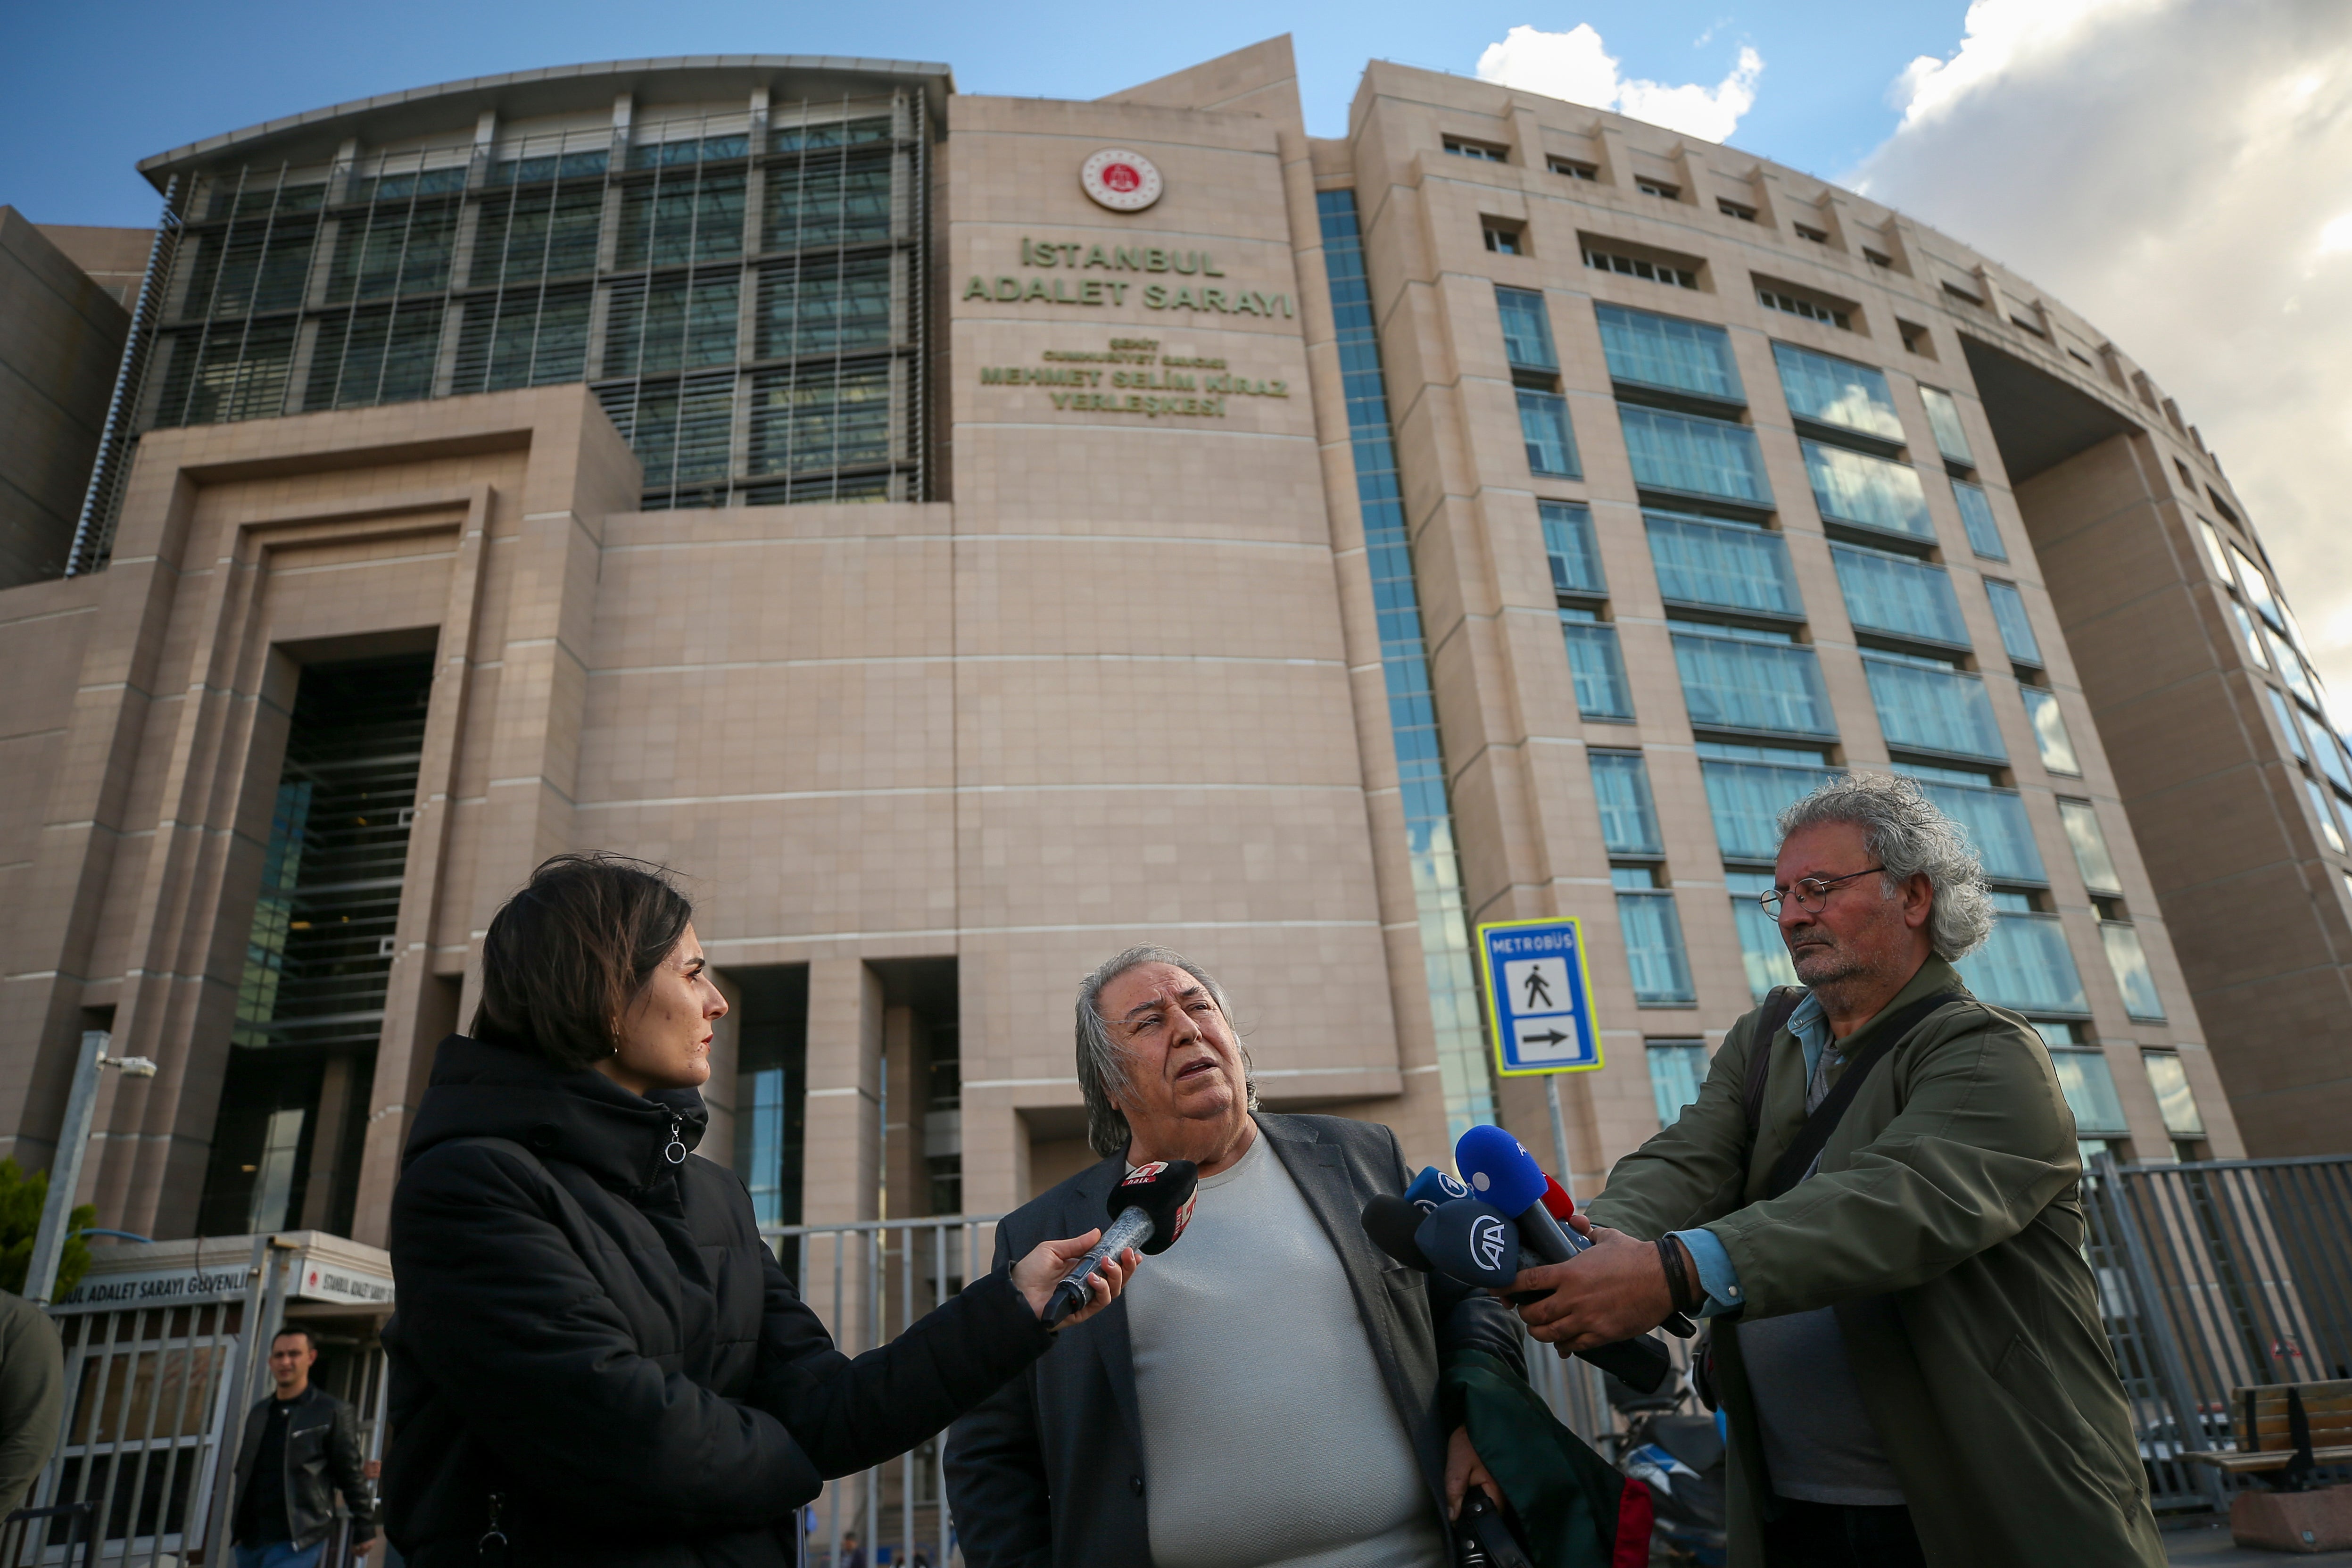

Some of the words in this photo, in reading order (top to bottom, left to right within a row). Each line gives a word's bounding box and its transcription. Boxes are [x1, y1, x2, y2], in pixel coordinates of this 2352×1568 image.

[1021, 237, 1225, 277] İSTANBUL
[963, 275, 1129, 306] ADALET
[1144, 285, 1293, 318] SARAYI
[981, 367, 1102, 387] MEHMET
[1112, 370, 1196, 391] SELİM
[1206, 373, 1289, 398] KİRAZ
[1049, 392, 1225, 417] YERLEŞKESİ
[1480, 1223, 1505, 1270] AA
[88, 1282, 137, 1303] ADALET
[140, 1278, 184, 1298] SARAYI
[188, 1269, 249, 1293] GÜVENLİ
